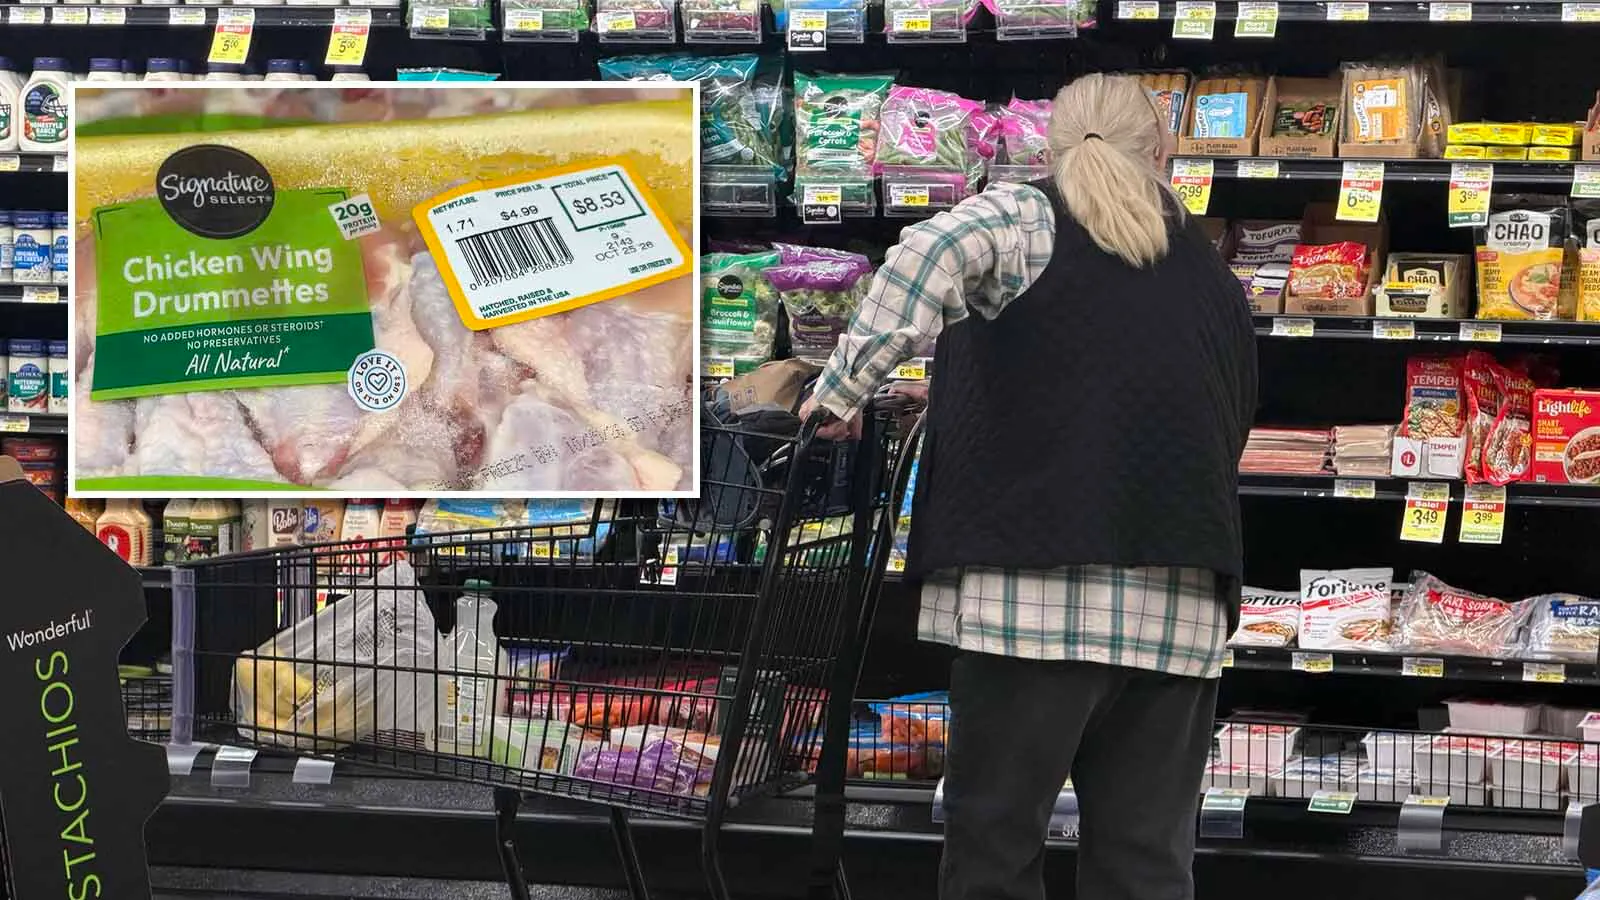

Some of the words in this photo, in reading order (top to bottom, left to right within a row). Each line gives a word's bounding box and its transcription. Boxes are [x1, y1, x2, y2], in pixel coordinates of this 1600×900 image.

[563, 179, 587, 188] TOTAL
[586, 173, 609, 184] PRICE
[160, 171, 270, 208] Signature
[495, 188, 516, 198] PRICE
[516, 186, 533, 194] PER
[572, 190, 626, 215] $8.53
[334, 202, 372, 221] 20g
[500, 205, 539, 222] $4.99
[343, 215, 377, 230] PROTEIN
[446, 217, 475, 234] 1.71
[1249, 226, 1295, 241] TOFURKY
[1494, 223, 1544, 241] CHAO
[606, 236, 633, 250] 2143
[595, 249, 621, 262] OCT
[621, 245, 638, 256] 25
[123, 251, 244, 284] Chicken
[250, 245, 333, 273] Wing
[1407, 275, 1438, 285] CHAO
[133, 278, 330, 318] Drummettes
[479, 297, 518, 313] HATCHED,
[518, 288, 546, 301] RAISED
[482, 301, 528, 319] HARVESTED
[538, 294, 554, 304] THE
[553, 290, 571, 300] USA
[143, 334, 160, 344] NO
[160, 330, 195, 342] ADDED
[195, 326, 254, 339] HORMONES
[254, 324, 270, 334] OR
[187, 341, 201, 350] NO
[203, 334, 282, 349] PRESERVATIVES
[185, 354, 209, 376] All
[356, 356, 382, 376] LOVE
[385, 360, 398, 372] IT
[1412, 374, 1459, 386] TEMPEH
[355, 381, 364, 394] OR
[363, 393, 379, 405] IT'S
[382, 393, 394, 403] ON
[1537, 399, 1592, 417] Lightlife
[1537, 419, 1559, 427] SMART
[1414, 501, 1440, 509] Sale!
[1472, 502, 1497, 510] Sale!
[1412, 509, 1438, 526] 349
[1473, 512, 1493, 525] 399
[7, 610, 91, 651] Wonderful
